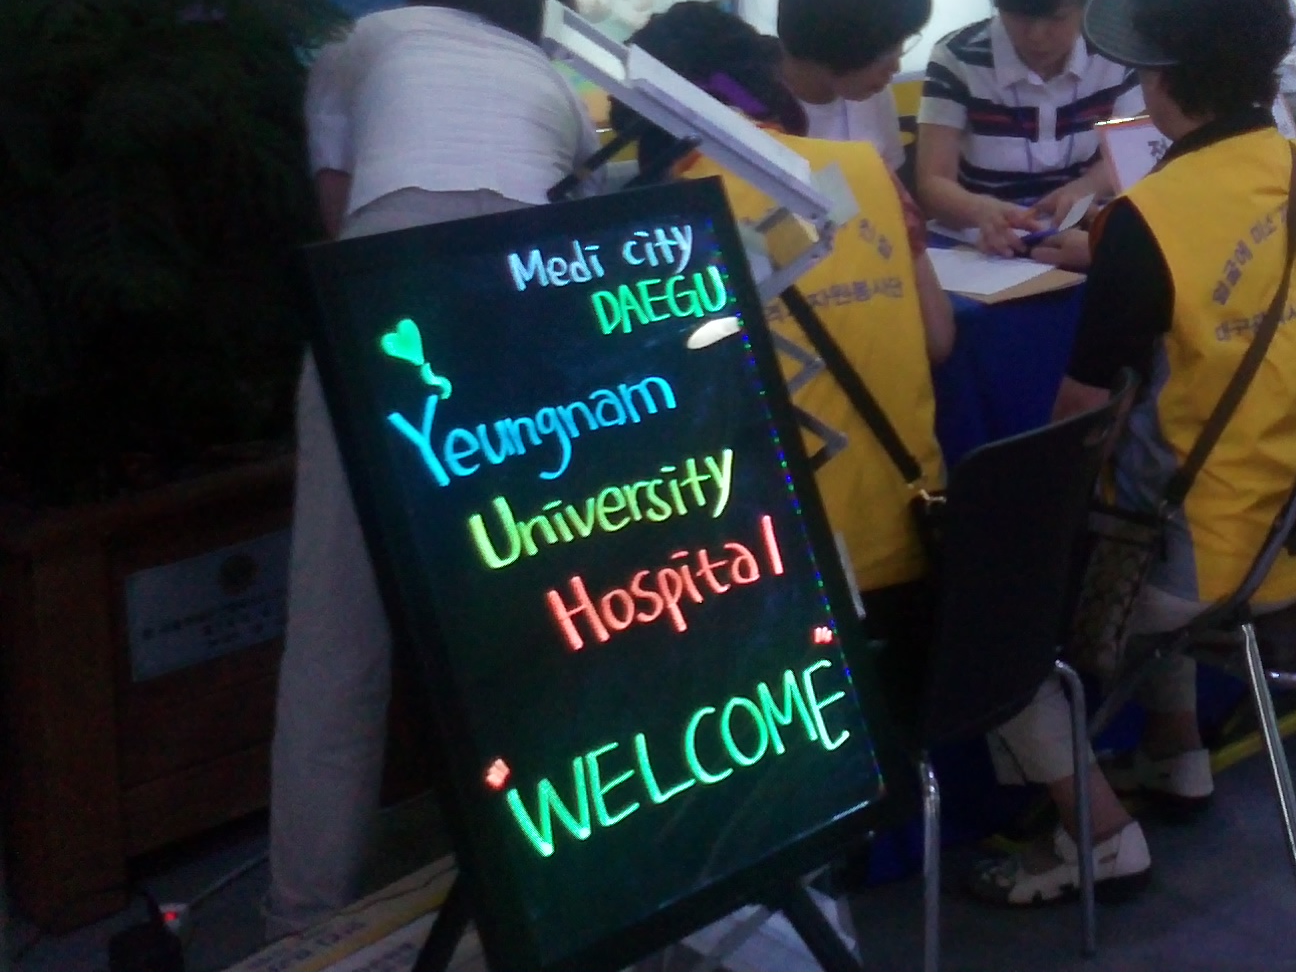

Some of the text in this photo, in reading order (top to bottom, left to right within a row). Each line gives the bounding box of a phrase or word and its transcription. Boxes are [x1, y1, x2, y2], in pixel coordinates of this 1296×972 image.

[507, 223, 694, 291] Medi city
[592, 264, 727, 335] DAEGU
[388, 375, 677, 487] Yeungnam
[467, 448, 735, 570] University
[546, 514, 785, 652] Hospital
[505, 658, 851, 857] WELCOME
